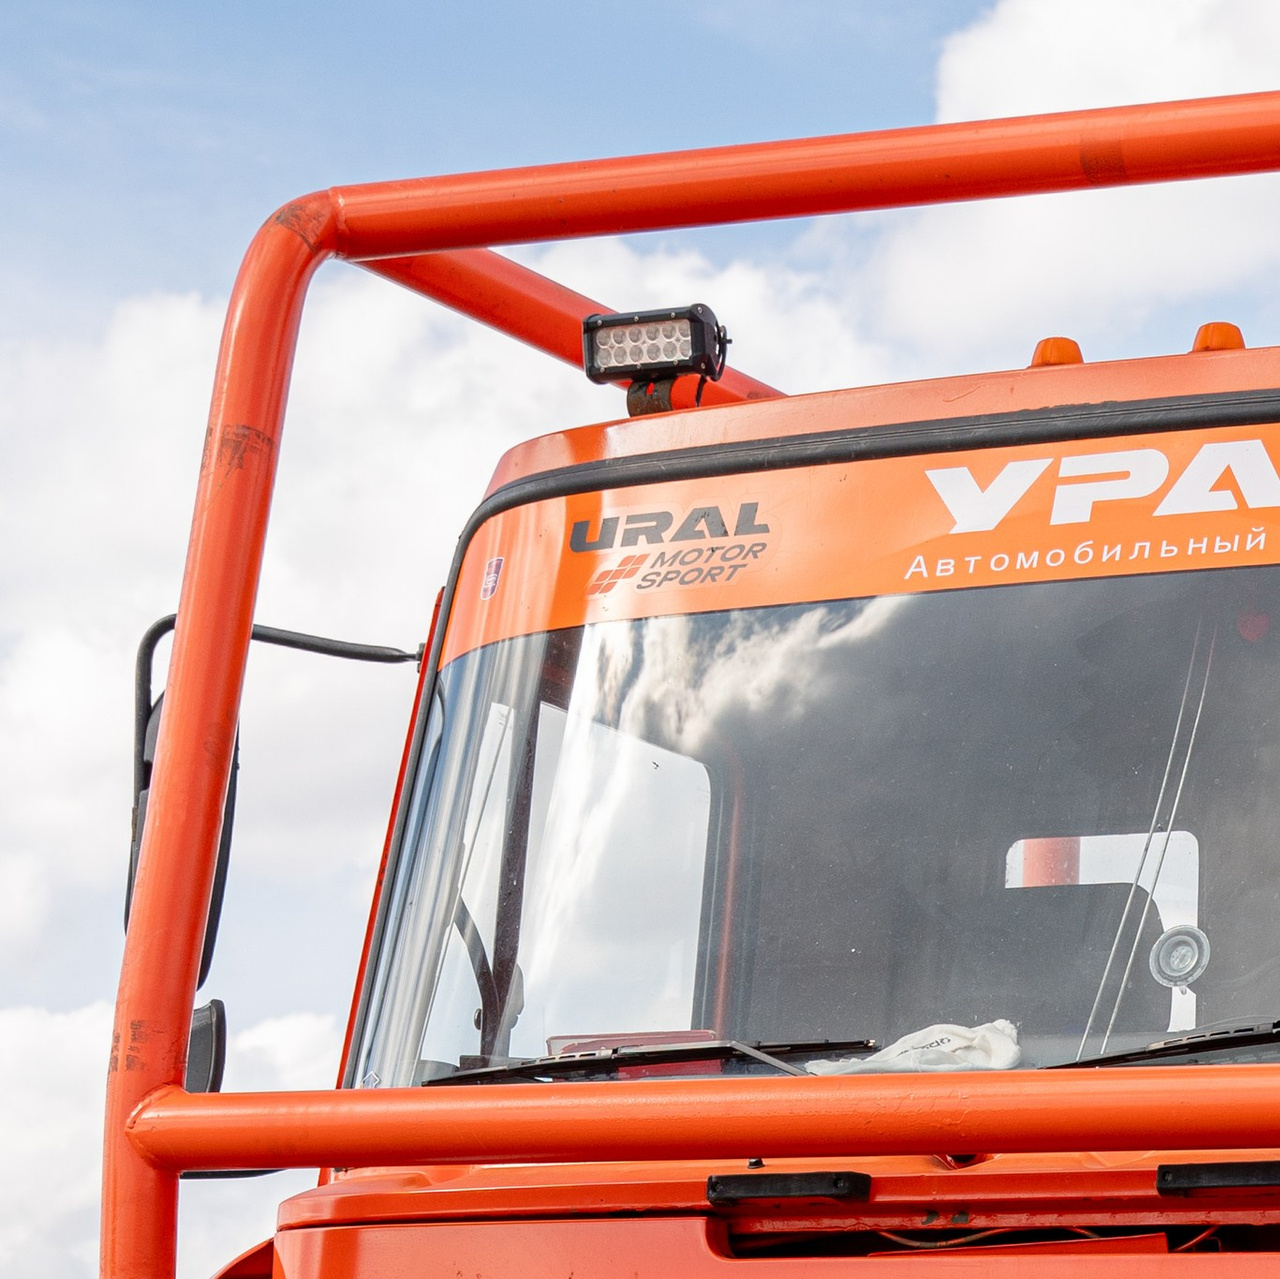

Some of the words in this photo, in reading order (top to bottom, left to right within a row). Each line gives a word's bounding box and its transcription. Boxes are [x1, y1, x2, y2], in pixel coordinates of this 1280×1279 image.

[570, 502, 770, 553] URAL
[649, 541, 767, 570] MOTOR
[904, 526, 1266, 580] Автомобильный
[636, 563, 748, 591] SPORT
